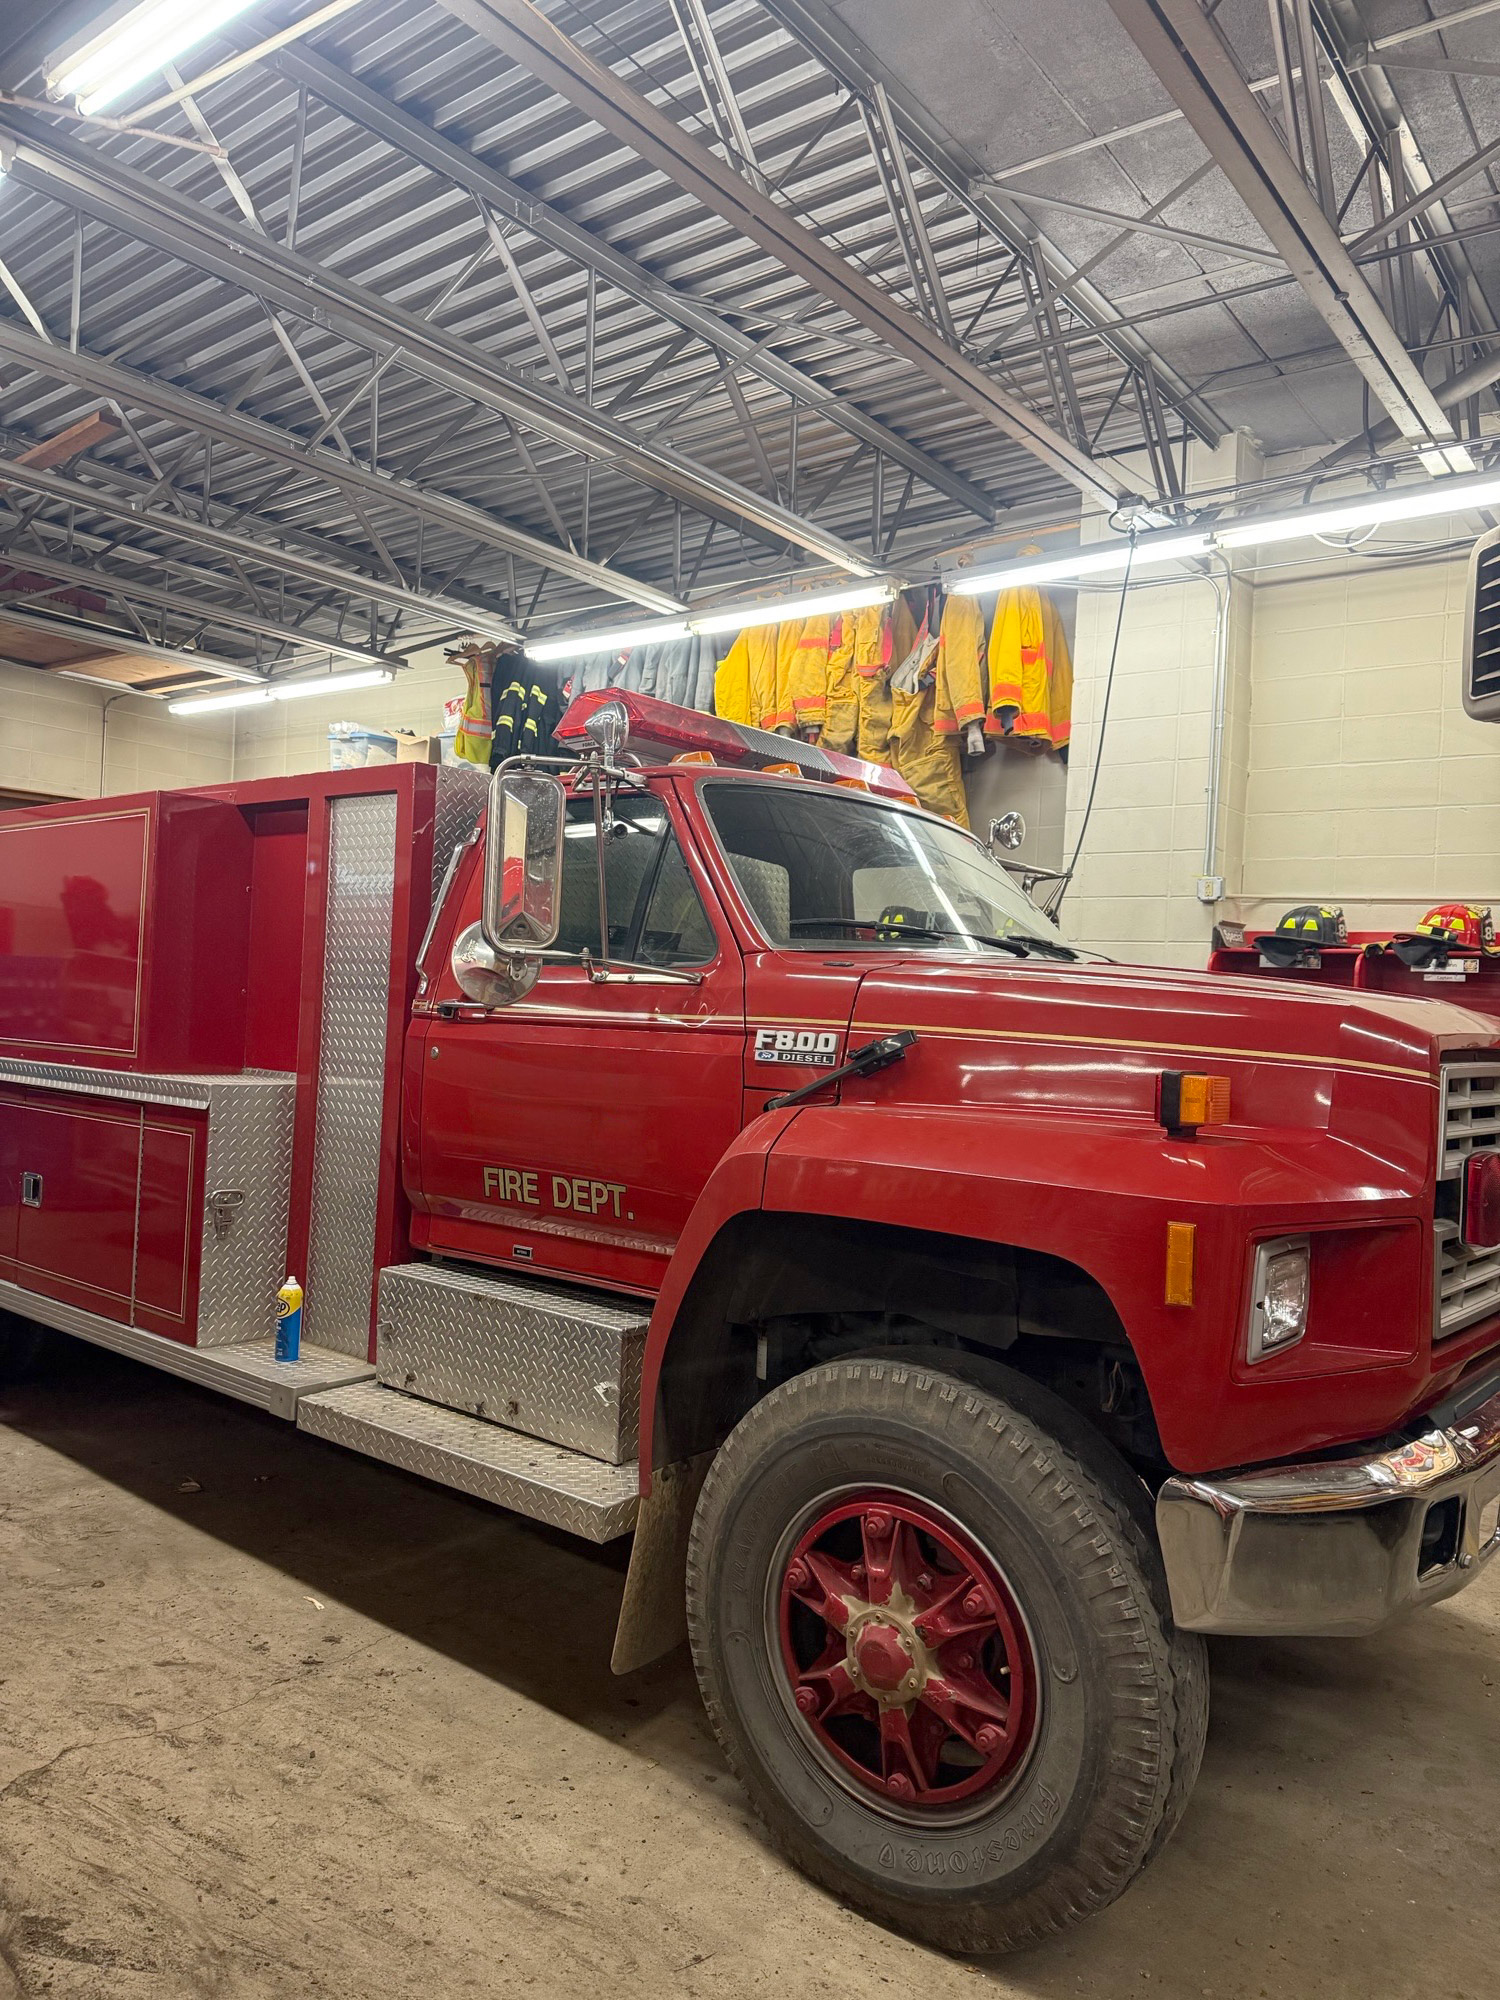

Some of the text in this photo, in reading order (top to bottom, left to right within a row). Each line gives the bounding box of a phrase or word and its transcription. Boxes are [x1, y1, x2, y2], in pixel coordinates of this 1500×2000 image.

[755, 1029, 837, 1053] F800
[782, 1053, 830, 1063] DIESEL
[483, 1166, 635, 1221] FIRE DEPT.
[906, 1781, 1061, 1876] Firestone
